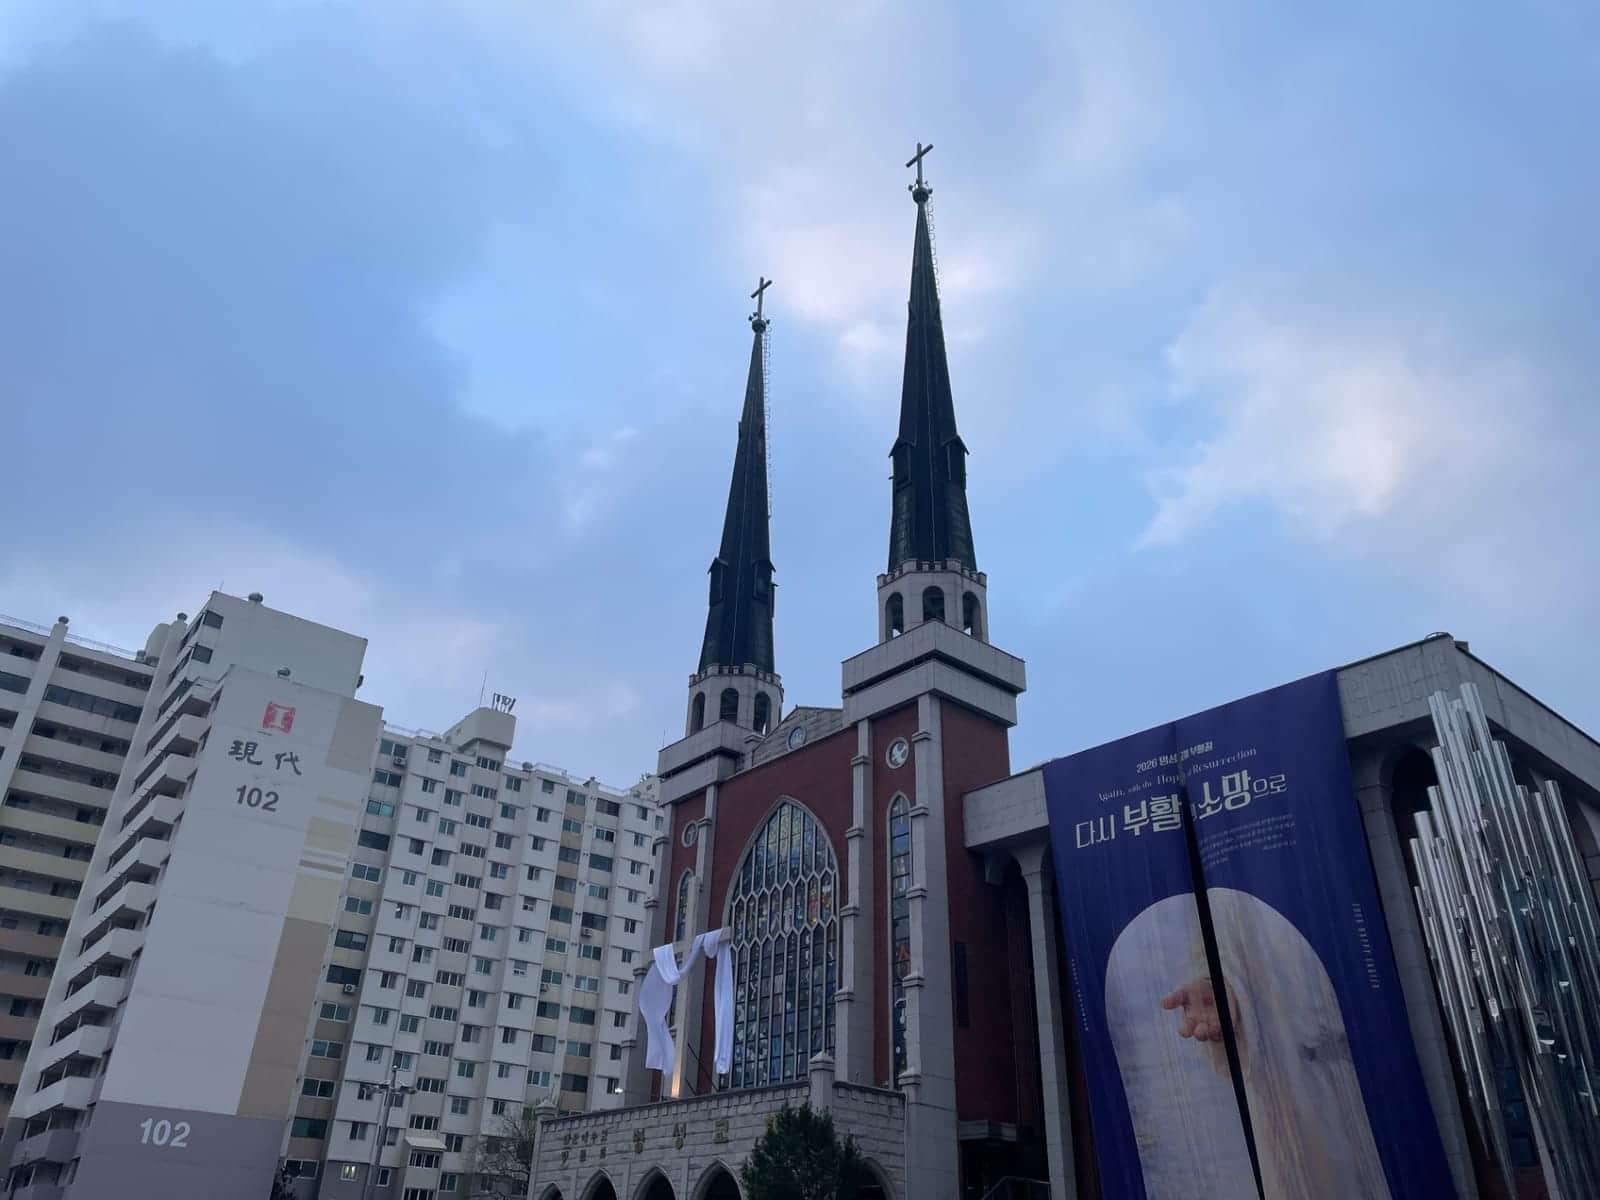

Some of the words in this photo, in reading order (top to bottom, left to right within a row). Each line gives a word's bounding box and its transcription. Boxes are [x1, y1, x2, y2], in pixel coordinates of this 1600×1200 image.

[228, 740, 302, 775] 現代
[1136, 758, 1157, 774] 2026
[1192, 747, 1257, 775] Resurrection
[236, 785, 279, 812] 102
[1075, 814, 1117, 849] 다시
[1198, 769, 1287, 820] 소망으로
[139, 1117, 191, 1148] 102
